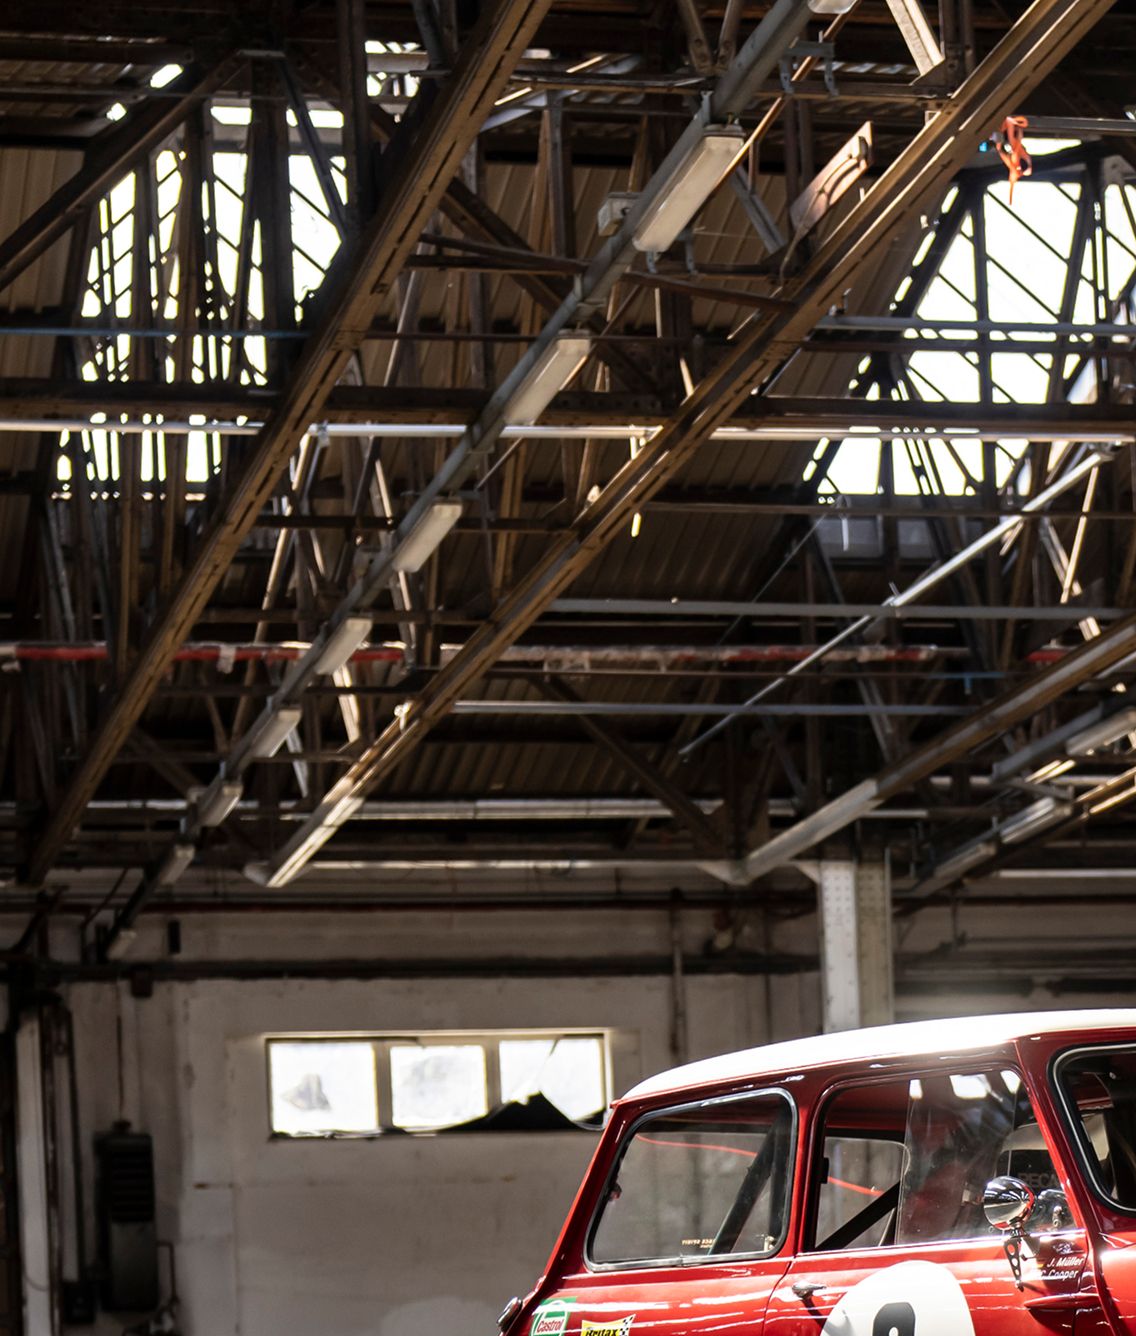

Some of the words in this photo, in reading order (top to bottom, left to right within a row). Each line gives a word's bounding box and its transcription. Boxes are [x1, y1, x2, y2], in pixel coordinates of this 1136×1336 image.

[1046, 1257, 1056, 1268] J.
[1056, 1256, 1084, 1267] Müller
[1048, 1269, 1079, 1281] Cooper
[536, 1318, 564, 1333] Castrol
